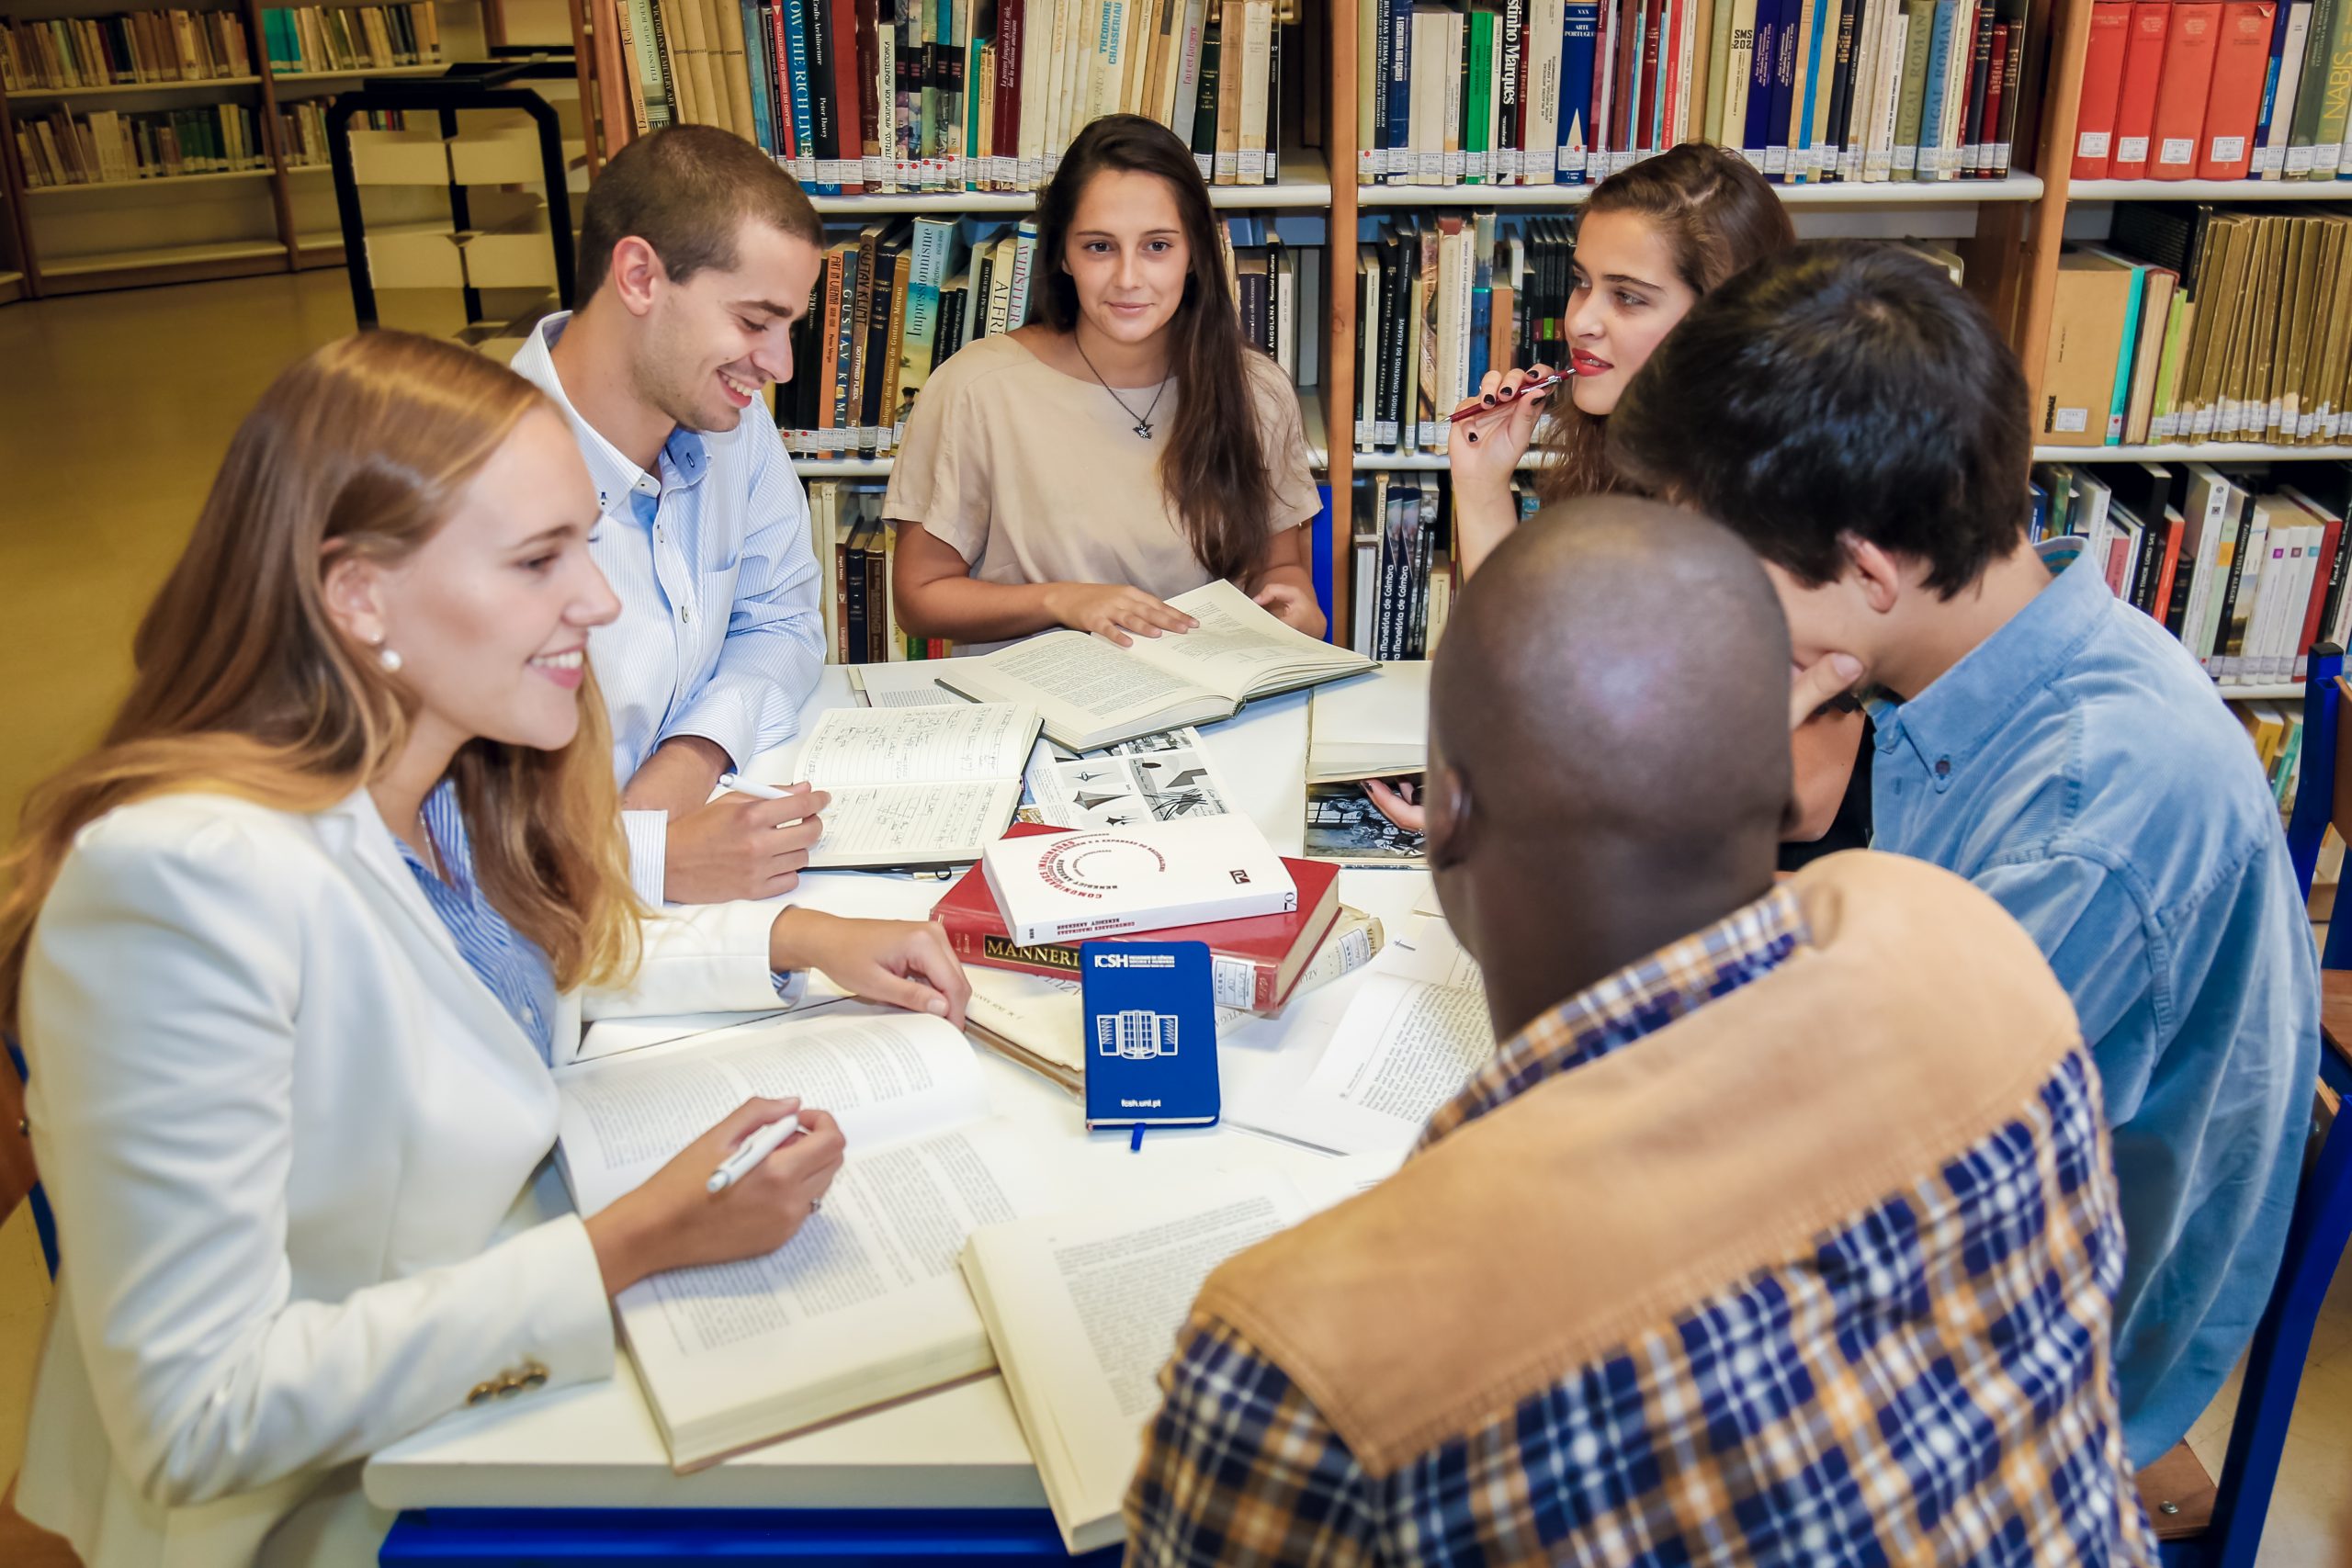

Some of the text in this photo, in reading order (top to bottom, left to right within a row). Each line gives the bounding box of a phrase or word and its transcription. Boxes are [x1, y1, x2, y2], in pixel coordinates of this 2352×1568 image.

[775, 21, 785, 62] ARCHITETTURA
[791, 30, 805, 65] THE
[813, 22, 823, 65] Architecture
[1394, 20, 1405, 50] ESCULTURA
[1735, 28, 1753, 39] SMS
[651, 5, 674, 107] VICTORIAN CEMETERY ART
[1395, 50, 1404, 61] NOS
[794, 70, 808, 108] RICH
[1501, 44, 1520, 105] Marques
[2323, 51, 2352, 118] NABIS
[819, 96, 829, 138] Peter Davey
[830, 255, 842, 270] ART
[854, 243, 873, 326] GUSTAV KLIMT
[893, 286, 903, 314] Moreau
[906, 228, 933, 337] Impressionnisme
[1009, 243, 1030, 323] WHISTLER
[838, 288, 852, 361] GUSTAV
[889, 315, 899, 345] Gustave
[853, 345, 862, 380] GOTTFRIED
[888, 346, 896, 356] de
[1389, 318, 1405, 420] ANTIGOS CONVENTOS DO ALGARVE
[885, 357, 895, 384] dessins
[2143, 547, 2153, 566] LORO
[2139, 565, 2149, 588] TIMOR
[2227, 554, 2243, 604] VISTA ALEGRE
[1379, 563, 1394, 651] Maneirista de Coimbra
[1393, 564, 1408, 651] Maneirista de Coimbra
[1038, 840, 1075, 870] IMAGINADAS
[1039, 871, 1102, 899] COMUNIDADES
[987, 939, 1080, 966] MANNERI
